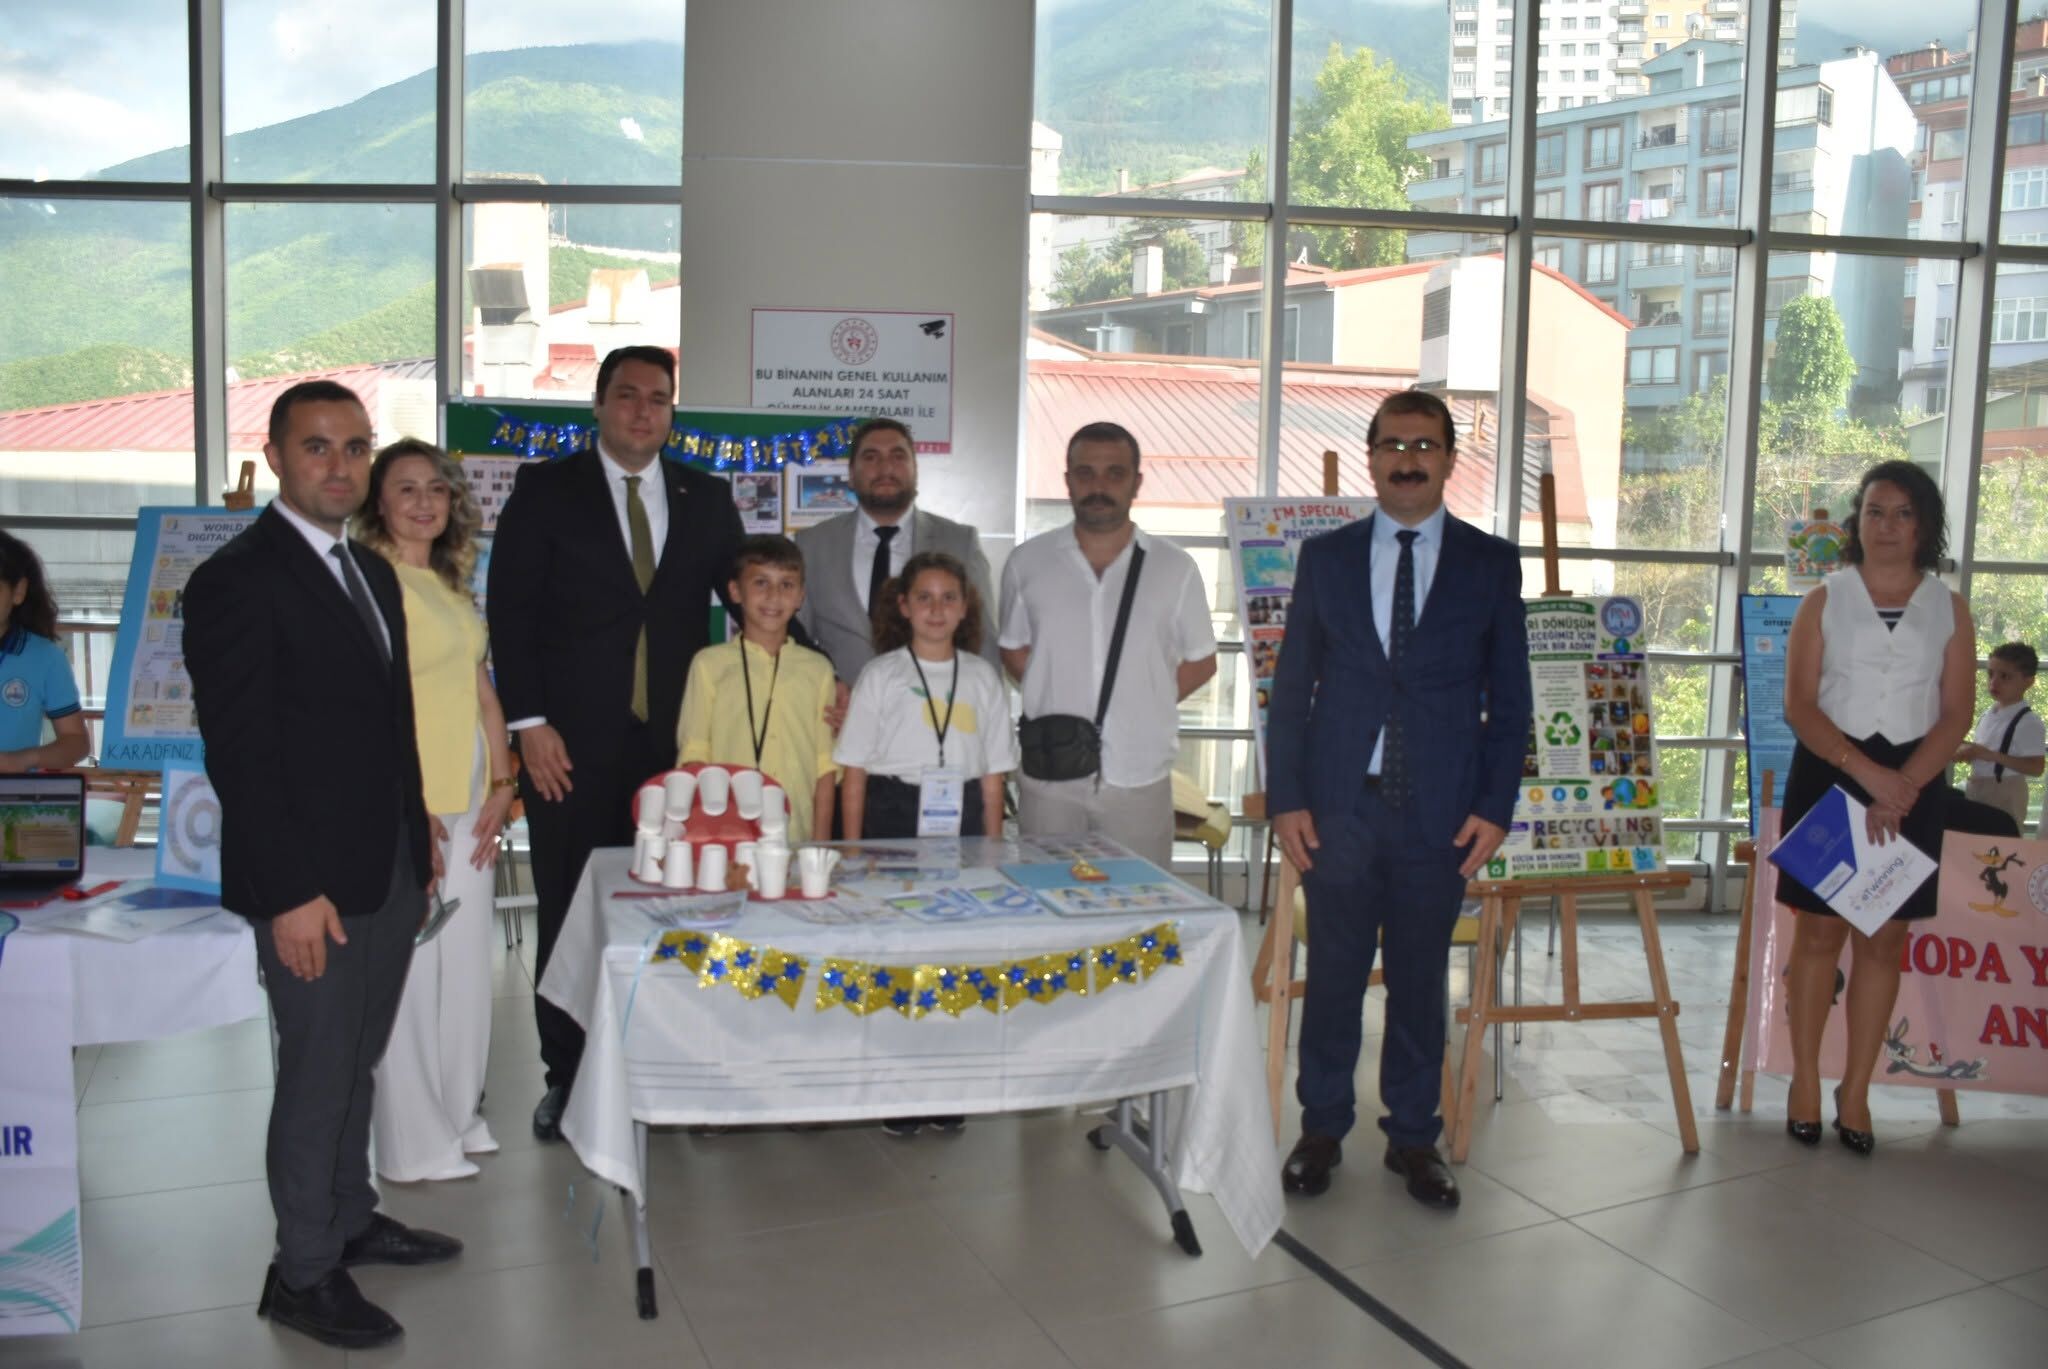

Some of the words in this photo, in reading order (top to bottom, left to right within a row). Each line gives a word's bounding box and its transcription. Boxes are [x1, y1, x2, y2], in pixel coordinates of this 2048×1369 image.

[756, 369, 773, 380] BU
[777, 367, 833, 380] BİNANIN
[837, 371, 878, 382] GENEL
[883, 372, 948, 384] KULLANIM
[793, 387, 855, 399] ALANLARI
[859, 388, 874, 399] 24
[878, 389, 911, 400] SAAT
[918, 407, 935, 417] İLE
[667, 429, 802, 464] UMHURİYET
[203, 523, 243, 532] WORLD
[187, 532, 226, 541] DIGITAL
[1543, 616, 1596, 631] DÖNÜŞÜM
[1534, 817, 1653, 836] RECYCLING
[1861, 856, 1905, 902] eTwinning
[0, 1125, 33, 1157] IR
